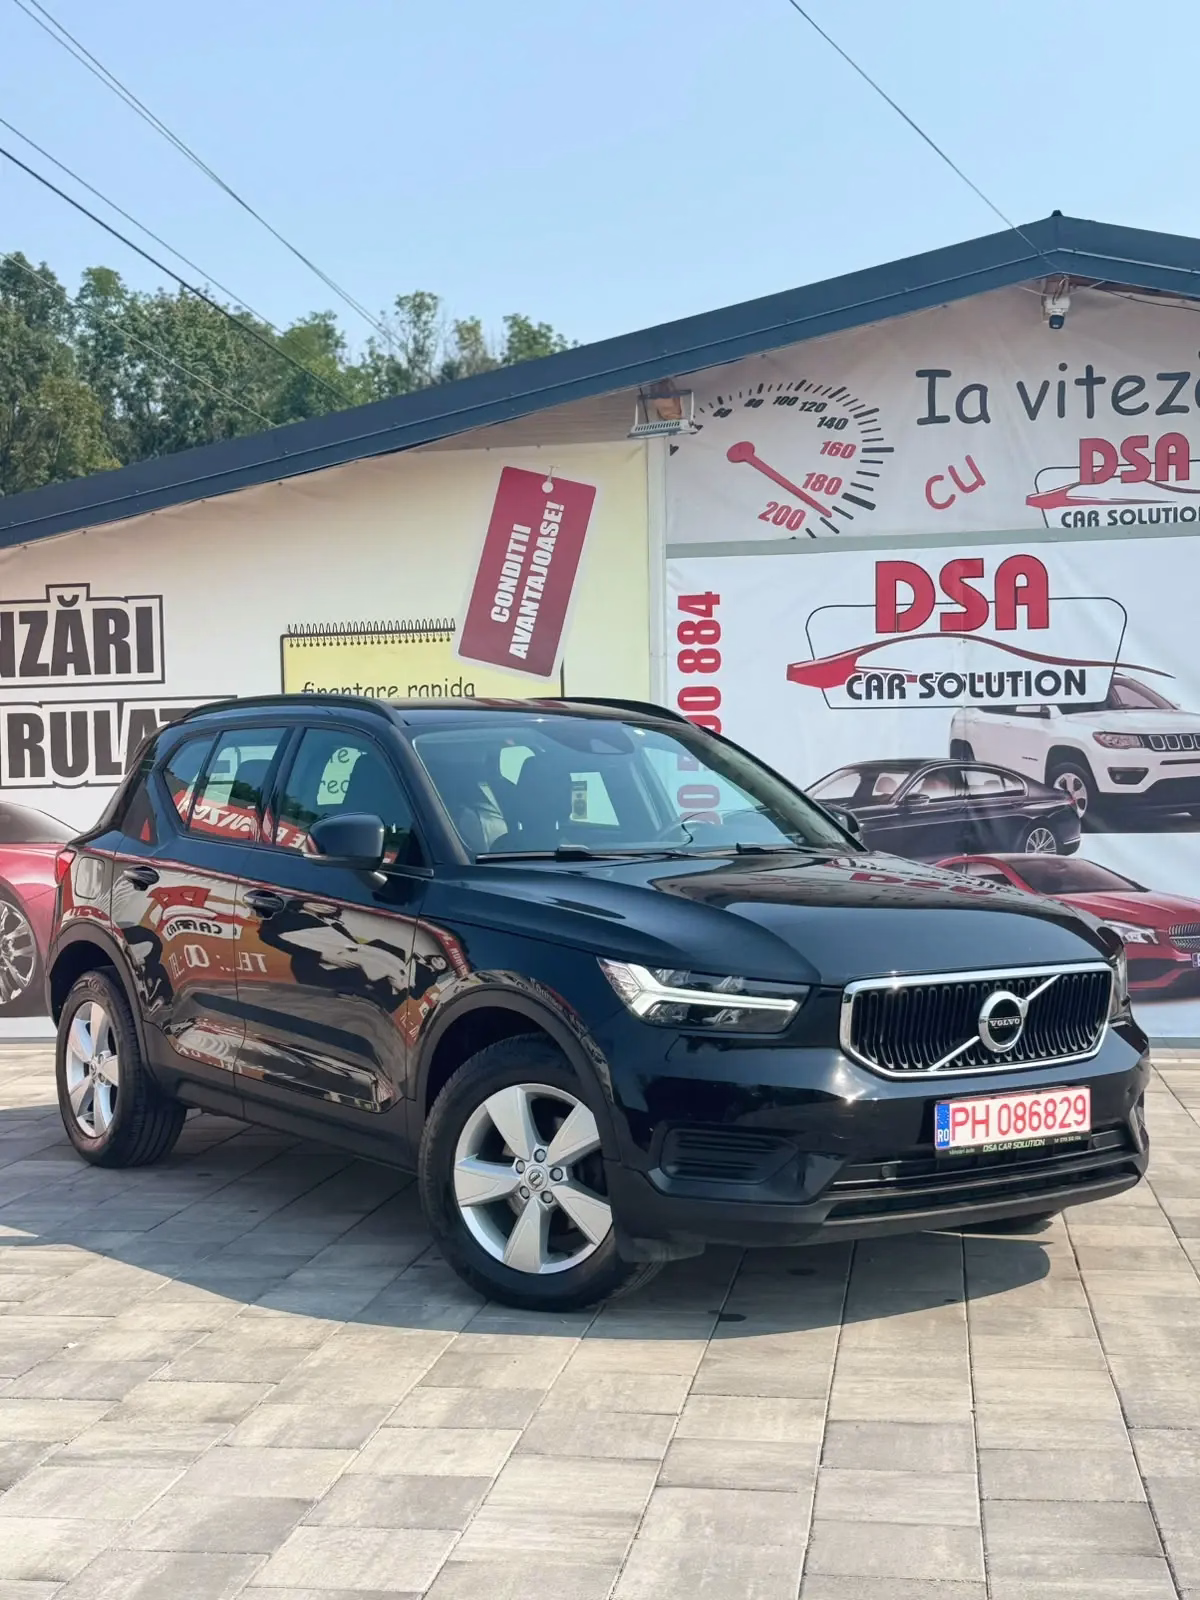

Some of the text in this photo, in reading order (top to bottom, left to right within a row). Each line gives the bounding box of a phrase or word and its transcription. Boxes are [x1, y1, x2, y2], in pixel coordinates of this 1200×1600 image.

[1016, 349, 1200, 421] vitez
[773, 396, 799, 406] 100
[799, 401, 828, 413] 120
[817, 416, 849, 430] 140
[820, 441, 857, 459] 160
[1079, 432, 1190, 484] DSA
[802, 472, 843, 495] 180
[925, 455, 986, 509] cu
[758, 501, 806, 531] 200
[1061, 506, 1200, 528] CAR SOLUTIO
[491, 523, 531, 623] CONDITII
[509, 501, 565, 660] AVANTAJOASE!
[875, 554, 1049, 633] DSA
[677, 591, 721, 674] 884
[846, 669, 1086, 700] CAR SOLUTION
[7, 708, 192, 779] RULA
[990, 1018, 1020, 1027] VOLVO
[951, 1094, 1086, 1141] PH 086829
[938, 1129, 950, 1142] RO
[983, 1144, 998, 1153] DSA
[998, 1142, 1012, 1151] CAR
[1013, 1139, 1046, 1149] SOLUTION
